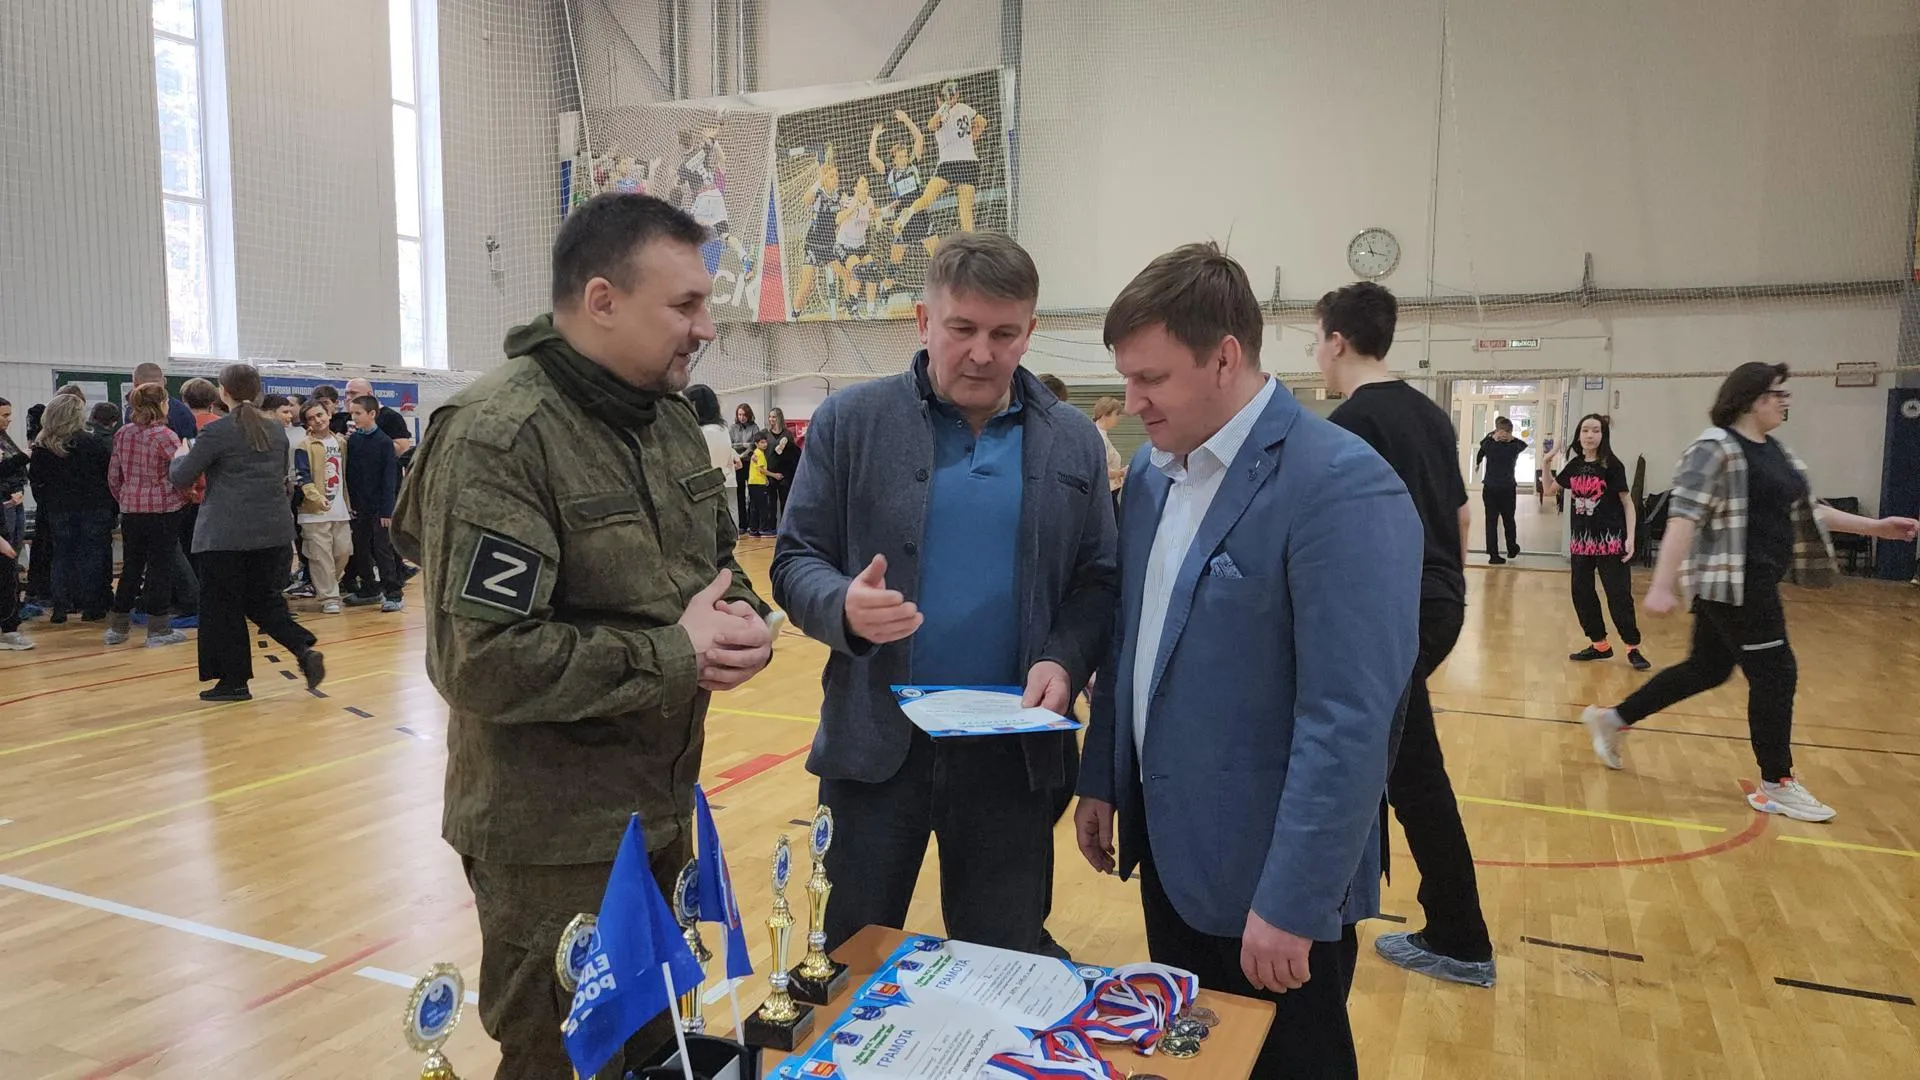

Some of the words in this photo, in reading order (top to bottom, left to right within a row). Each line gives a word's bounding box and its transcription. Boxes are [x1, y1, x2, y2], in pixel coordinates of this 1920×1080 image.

[482, 552, 527, 597] Z
[936, 959, 970, 990] ГРАМОТА
[876, 1029, 915, 1069] ГРАМОТА
